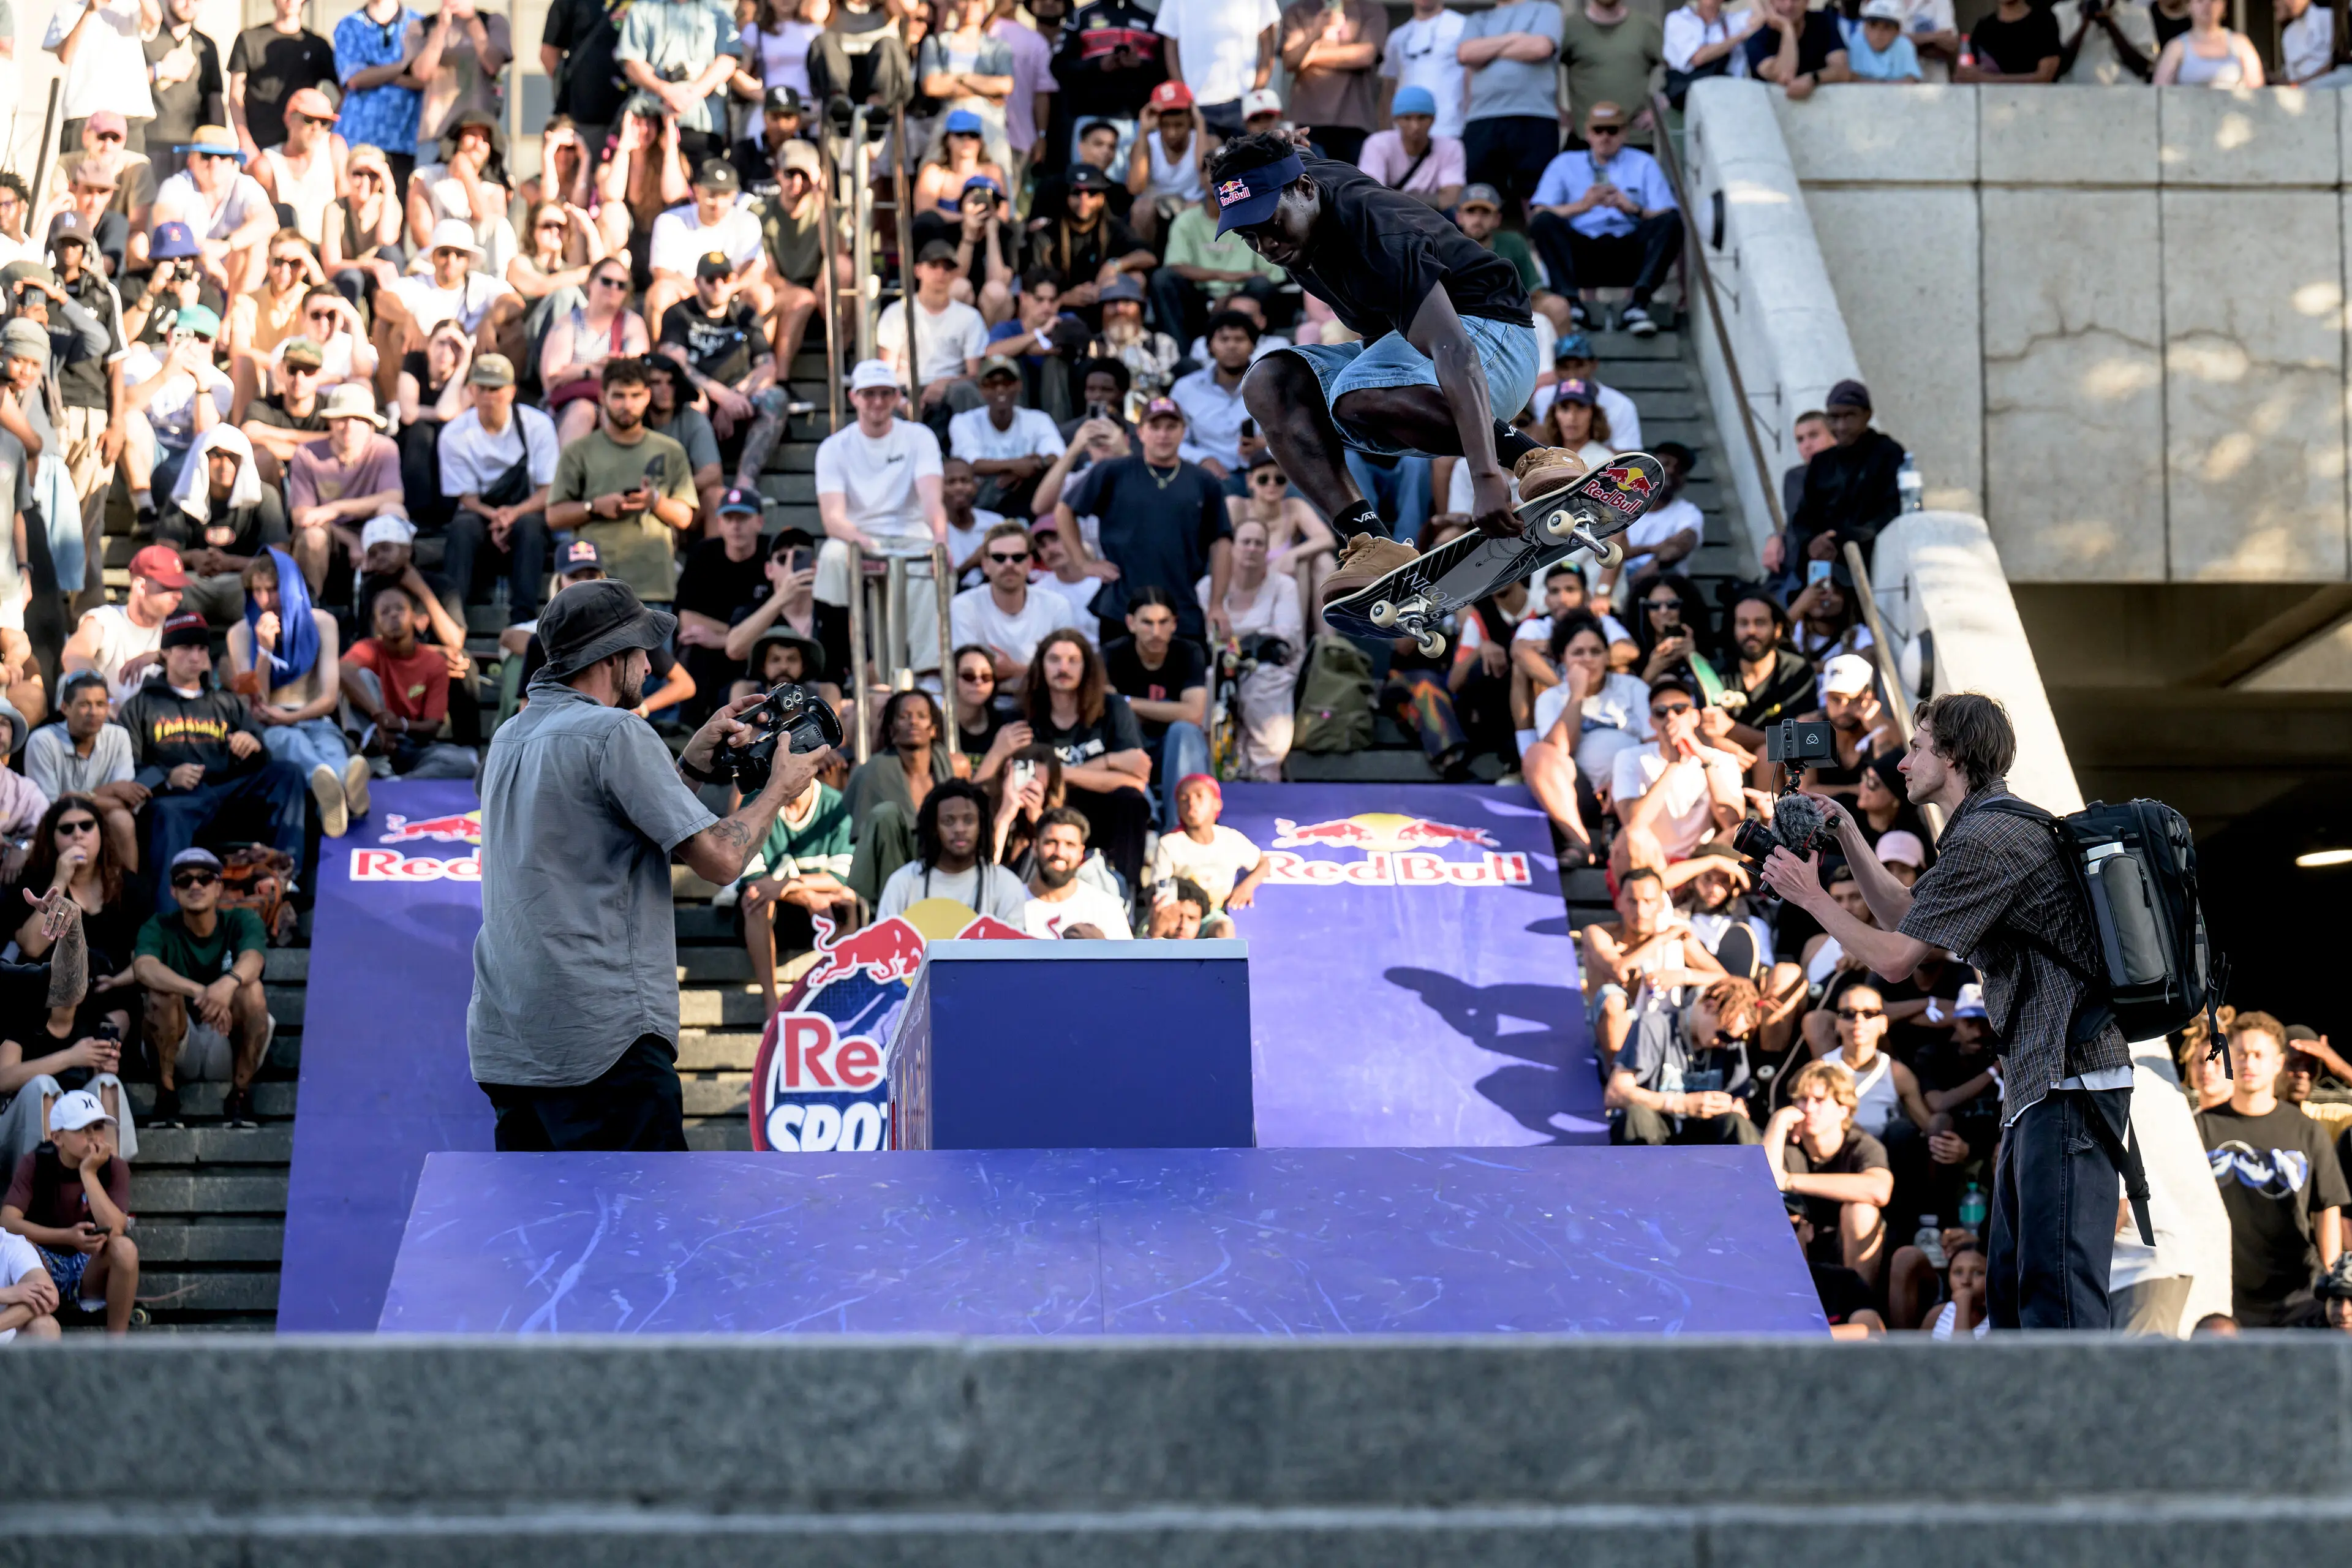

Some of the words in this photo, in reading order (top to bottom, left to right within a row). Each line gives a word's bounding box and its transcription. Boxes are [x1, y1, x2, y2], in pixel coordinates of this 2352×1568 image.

[1220, 192, 1233, 206] Red
[1232, 187, 1250, 201] Bull
[1581, 479, 1619, 503] Red
[1608, 492, 1644, 514] Bull
[1353, 511, 1378, 522] VAN
[353, 850, 481, 879] Red
[1263, 853, 1392, 883] Red
[1397, 853, 1529, 884] Bull
[781, 1014, 886, 1090] Re
[767, 1101, 888, 1152] SPO
